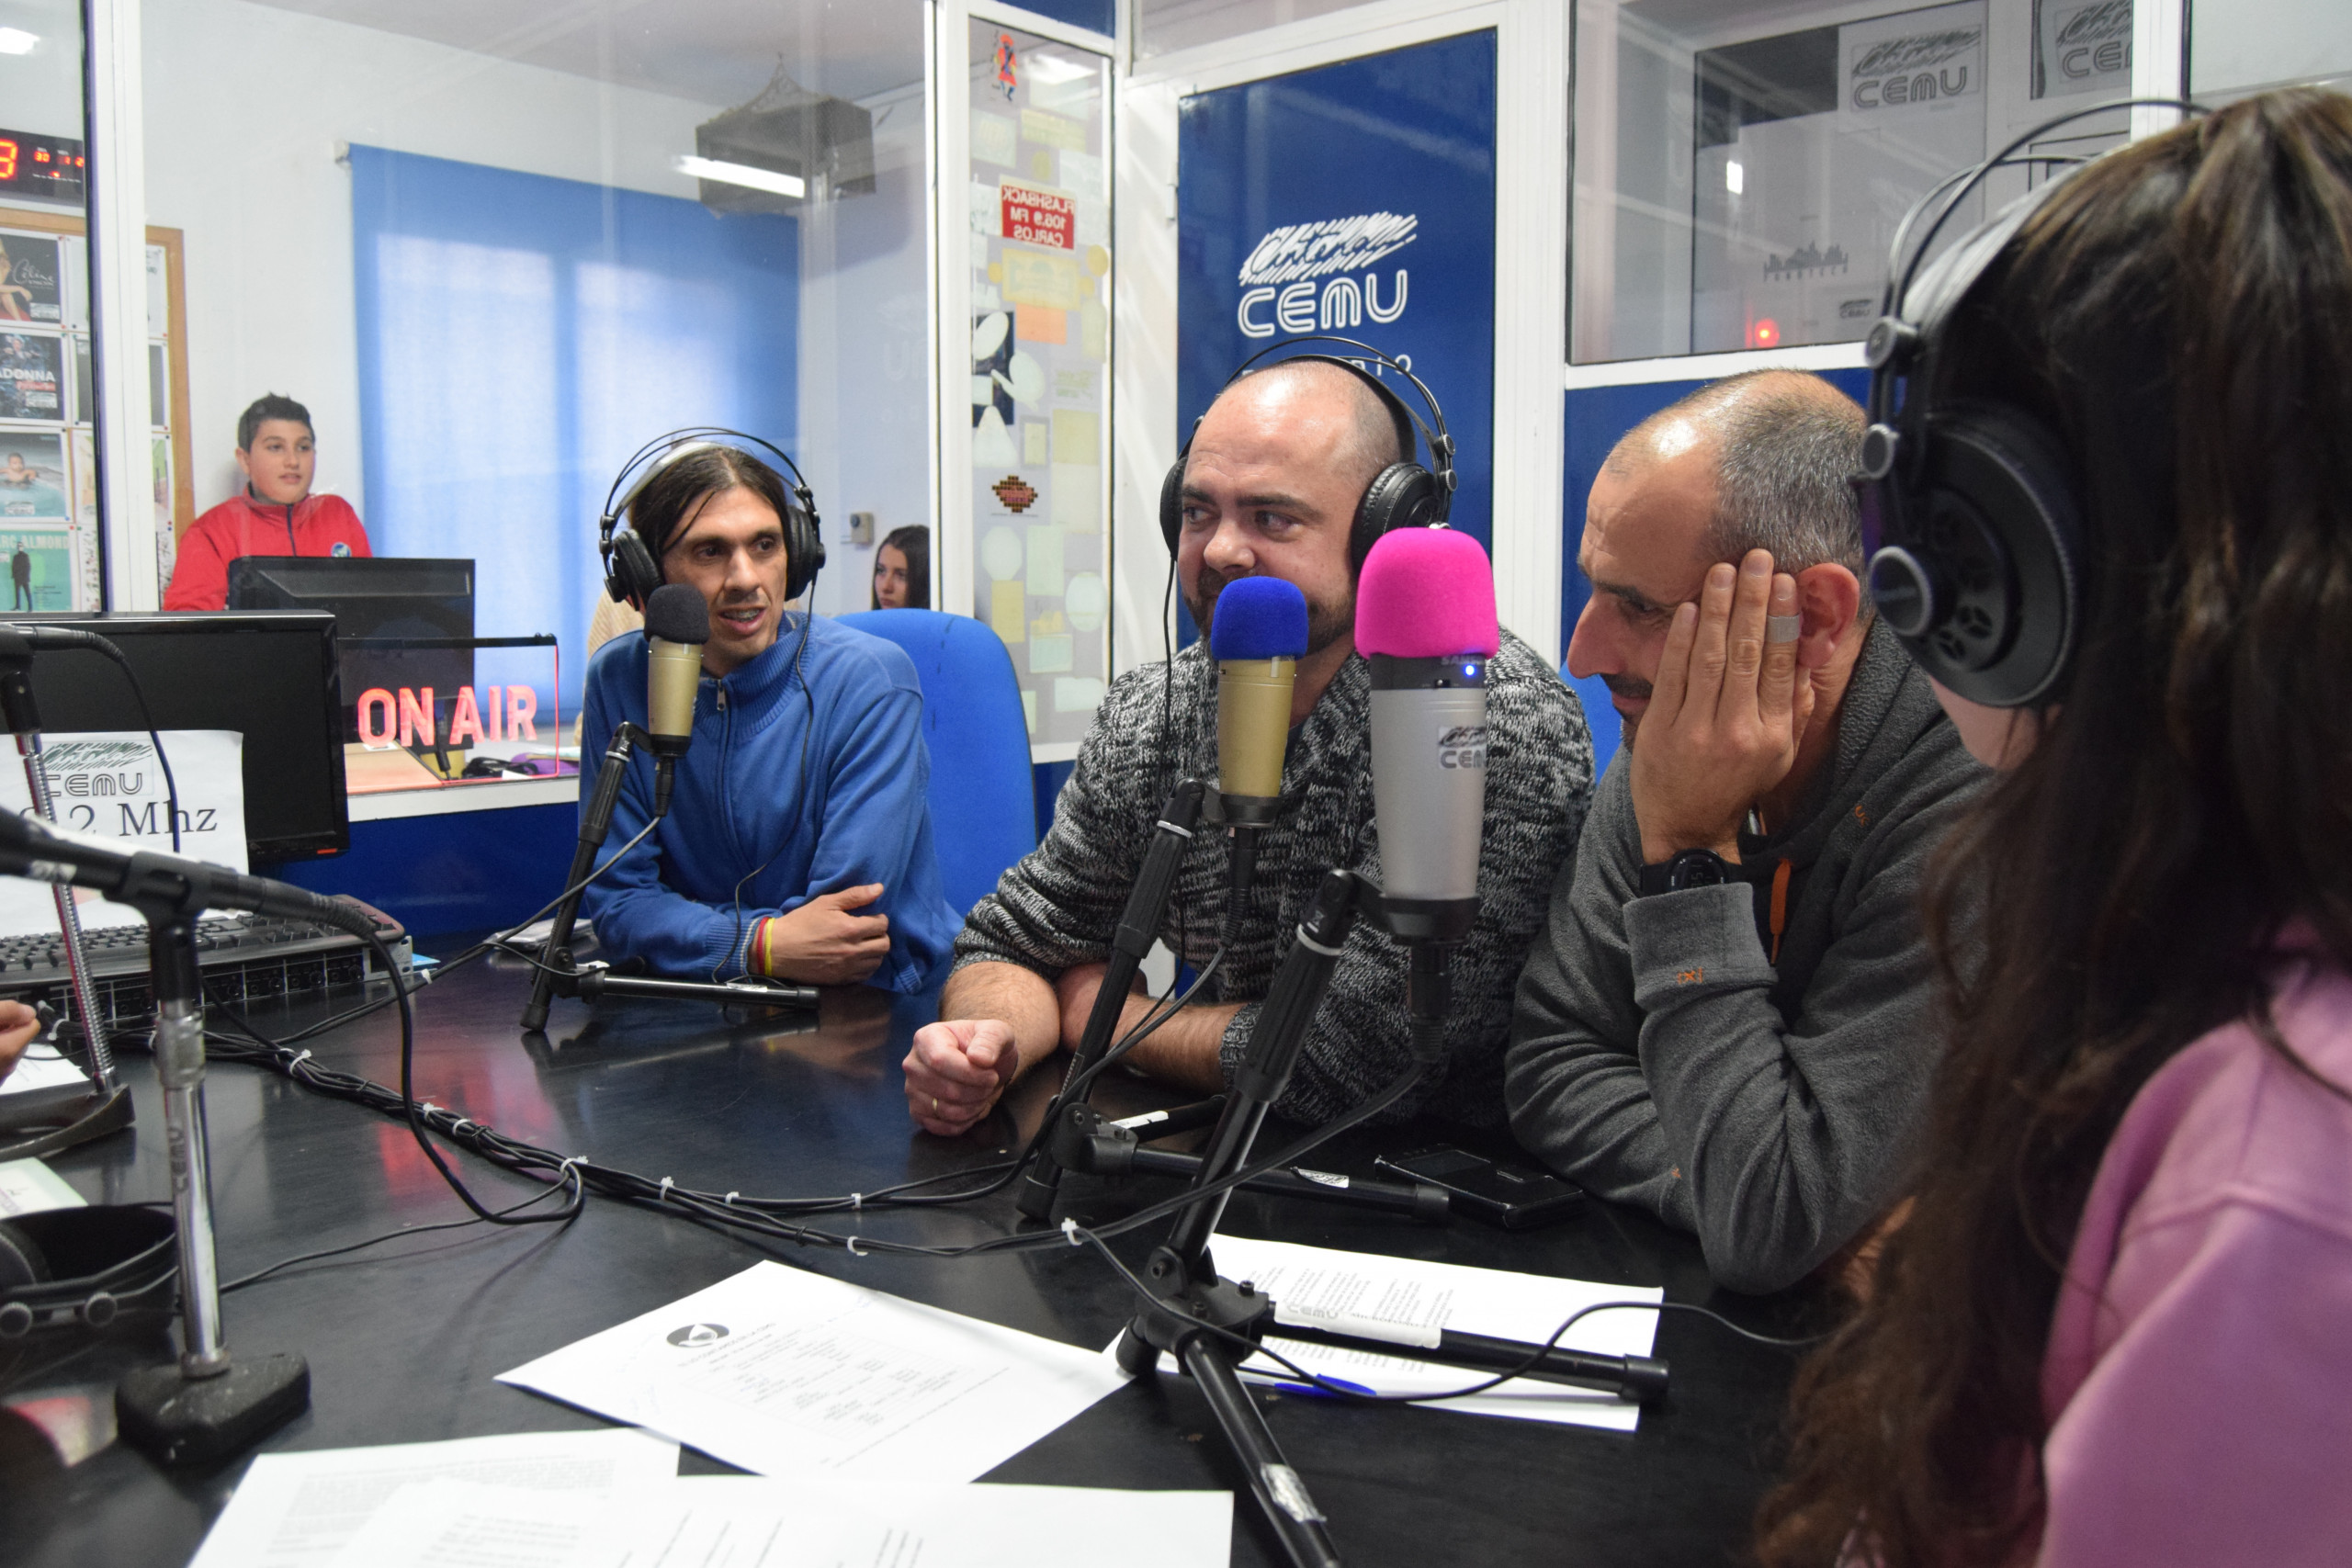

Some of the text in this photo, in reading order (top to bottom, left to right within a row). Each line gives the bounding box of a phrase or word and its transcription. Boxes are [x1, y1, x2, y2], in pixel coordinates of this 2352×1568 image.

[2062, 41, 2132, 79] CE
[1853, 65, 1967, 108] CEMU
[1238, 269, 1408, 338] CEMU
[357, 685, 537, 748] ON AIR
[117, 799, 218, 837] Mhz
[1286, 1303, 1339, 1320] CEMU
